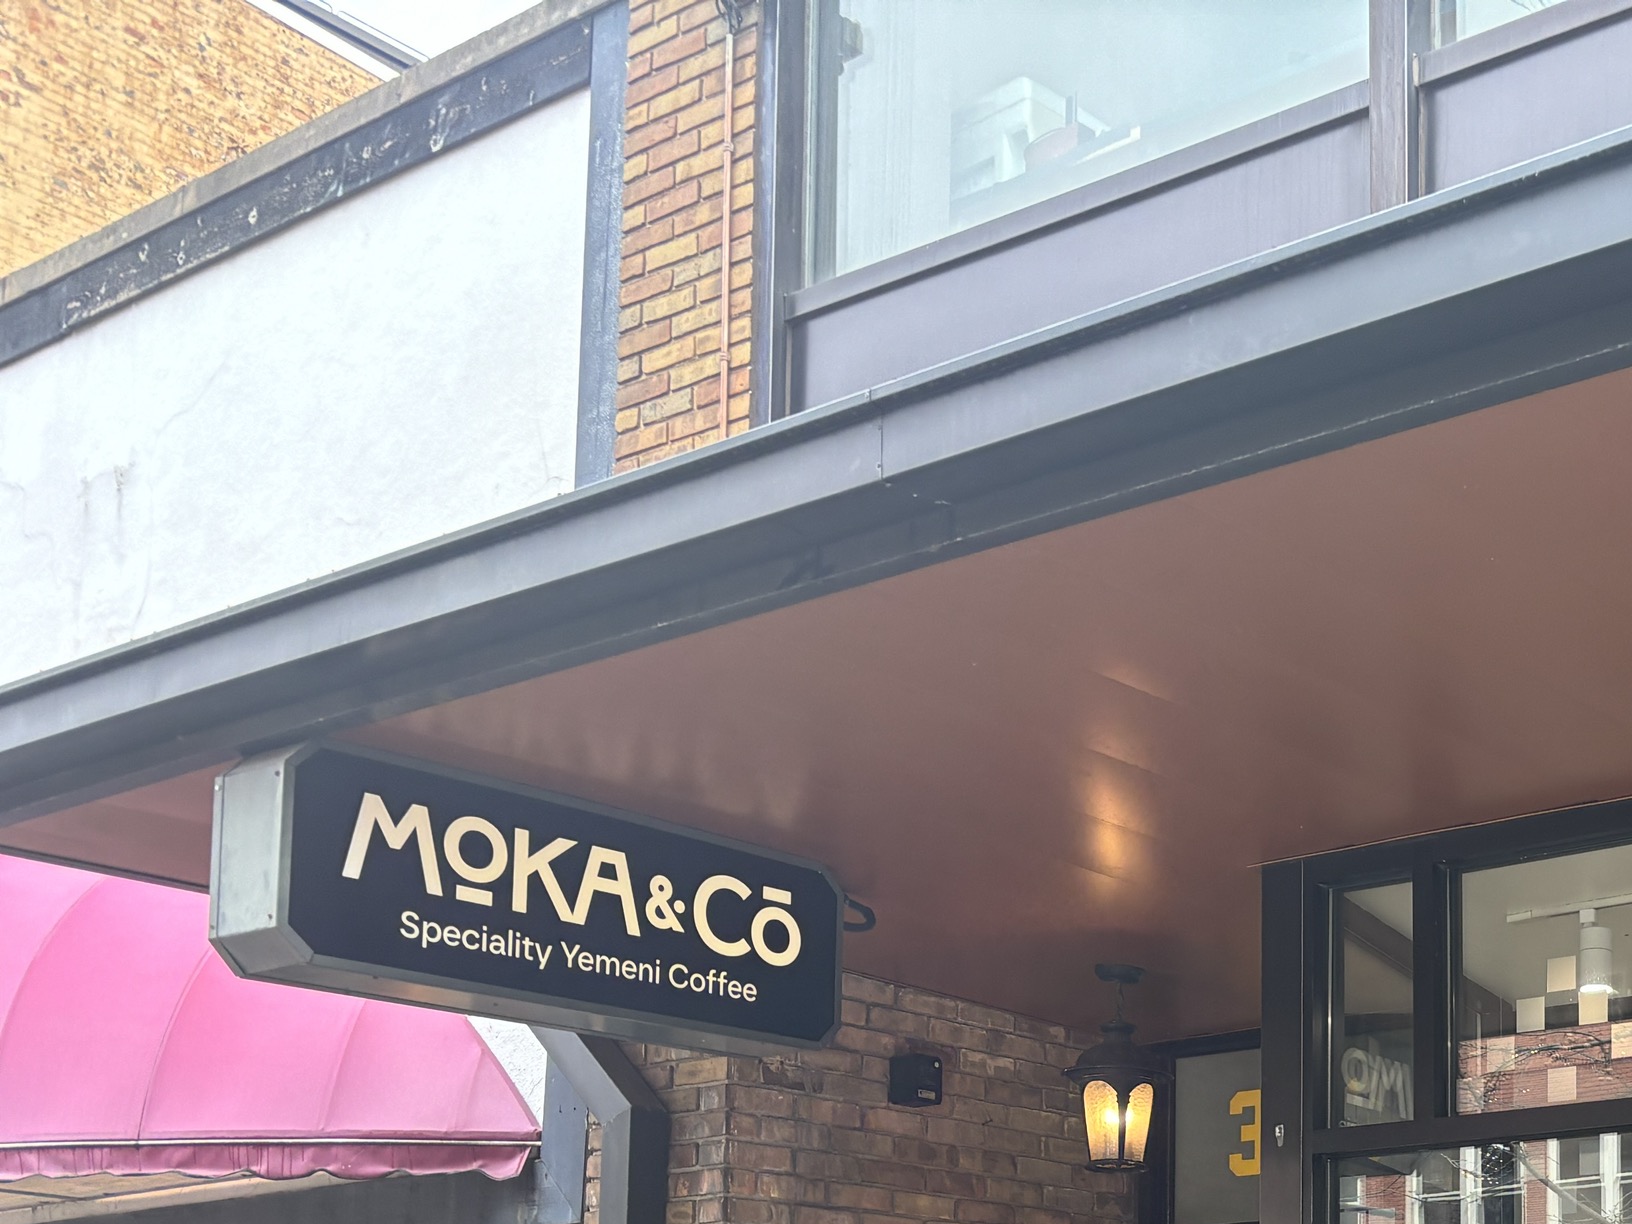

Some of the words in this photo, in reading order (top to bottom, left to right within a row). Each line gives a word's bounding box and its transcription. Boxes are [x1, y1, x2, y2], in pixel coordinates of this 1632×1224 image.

[399, 911, 553, 970] Speciality
[561, 941, 661, 985] Yemeni
[668, 964, 758, 1003] Coffee
